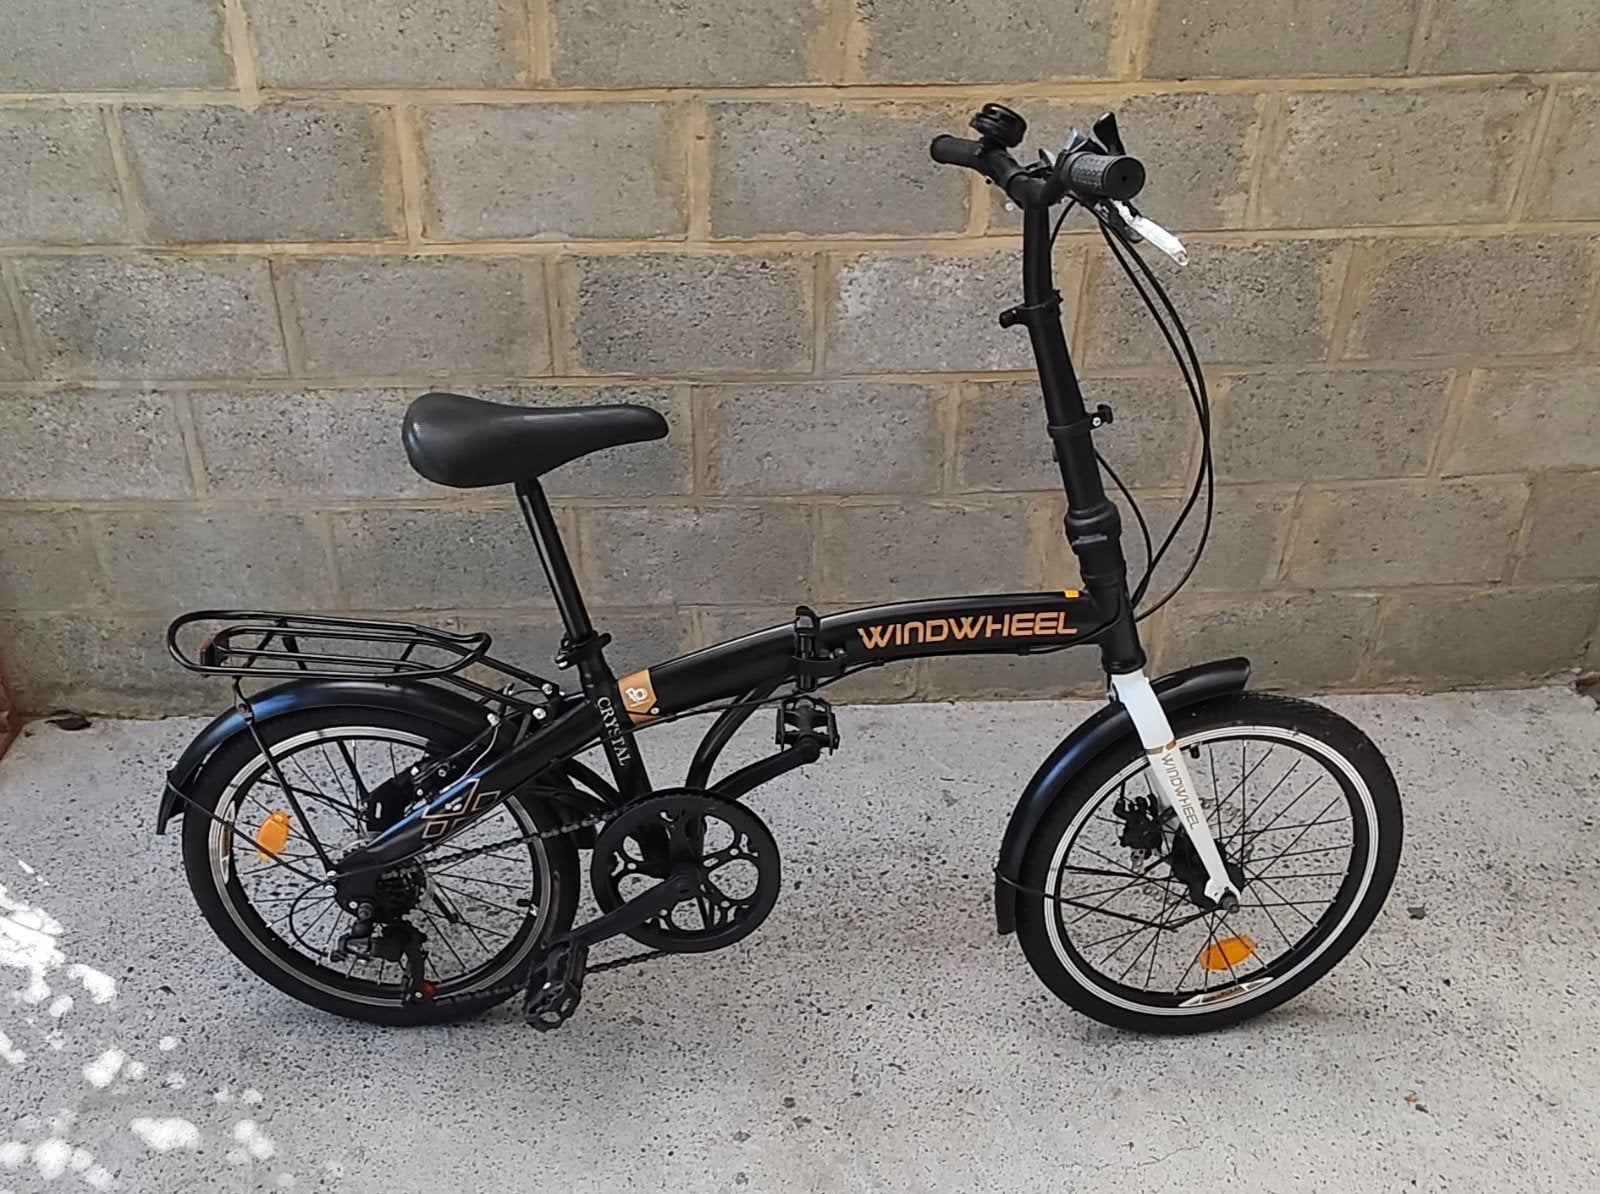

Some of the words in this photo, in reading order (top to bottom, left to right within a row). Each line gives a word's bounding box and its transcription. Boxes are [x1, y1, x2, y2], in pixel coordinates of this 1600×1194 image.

[857, 612, 1078, 650] WINDWHEEL
[597, 696, 631, 766] CRYSTAL
[1161, 753, 1199, 830] WINDWHEEL
